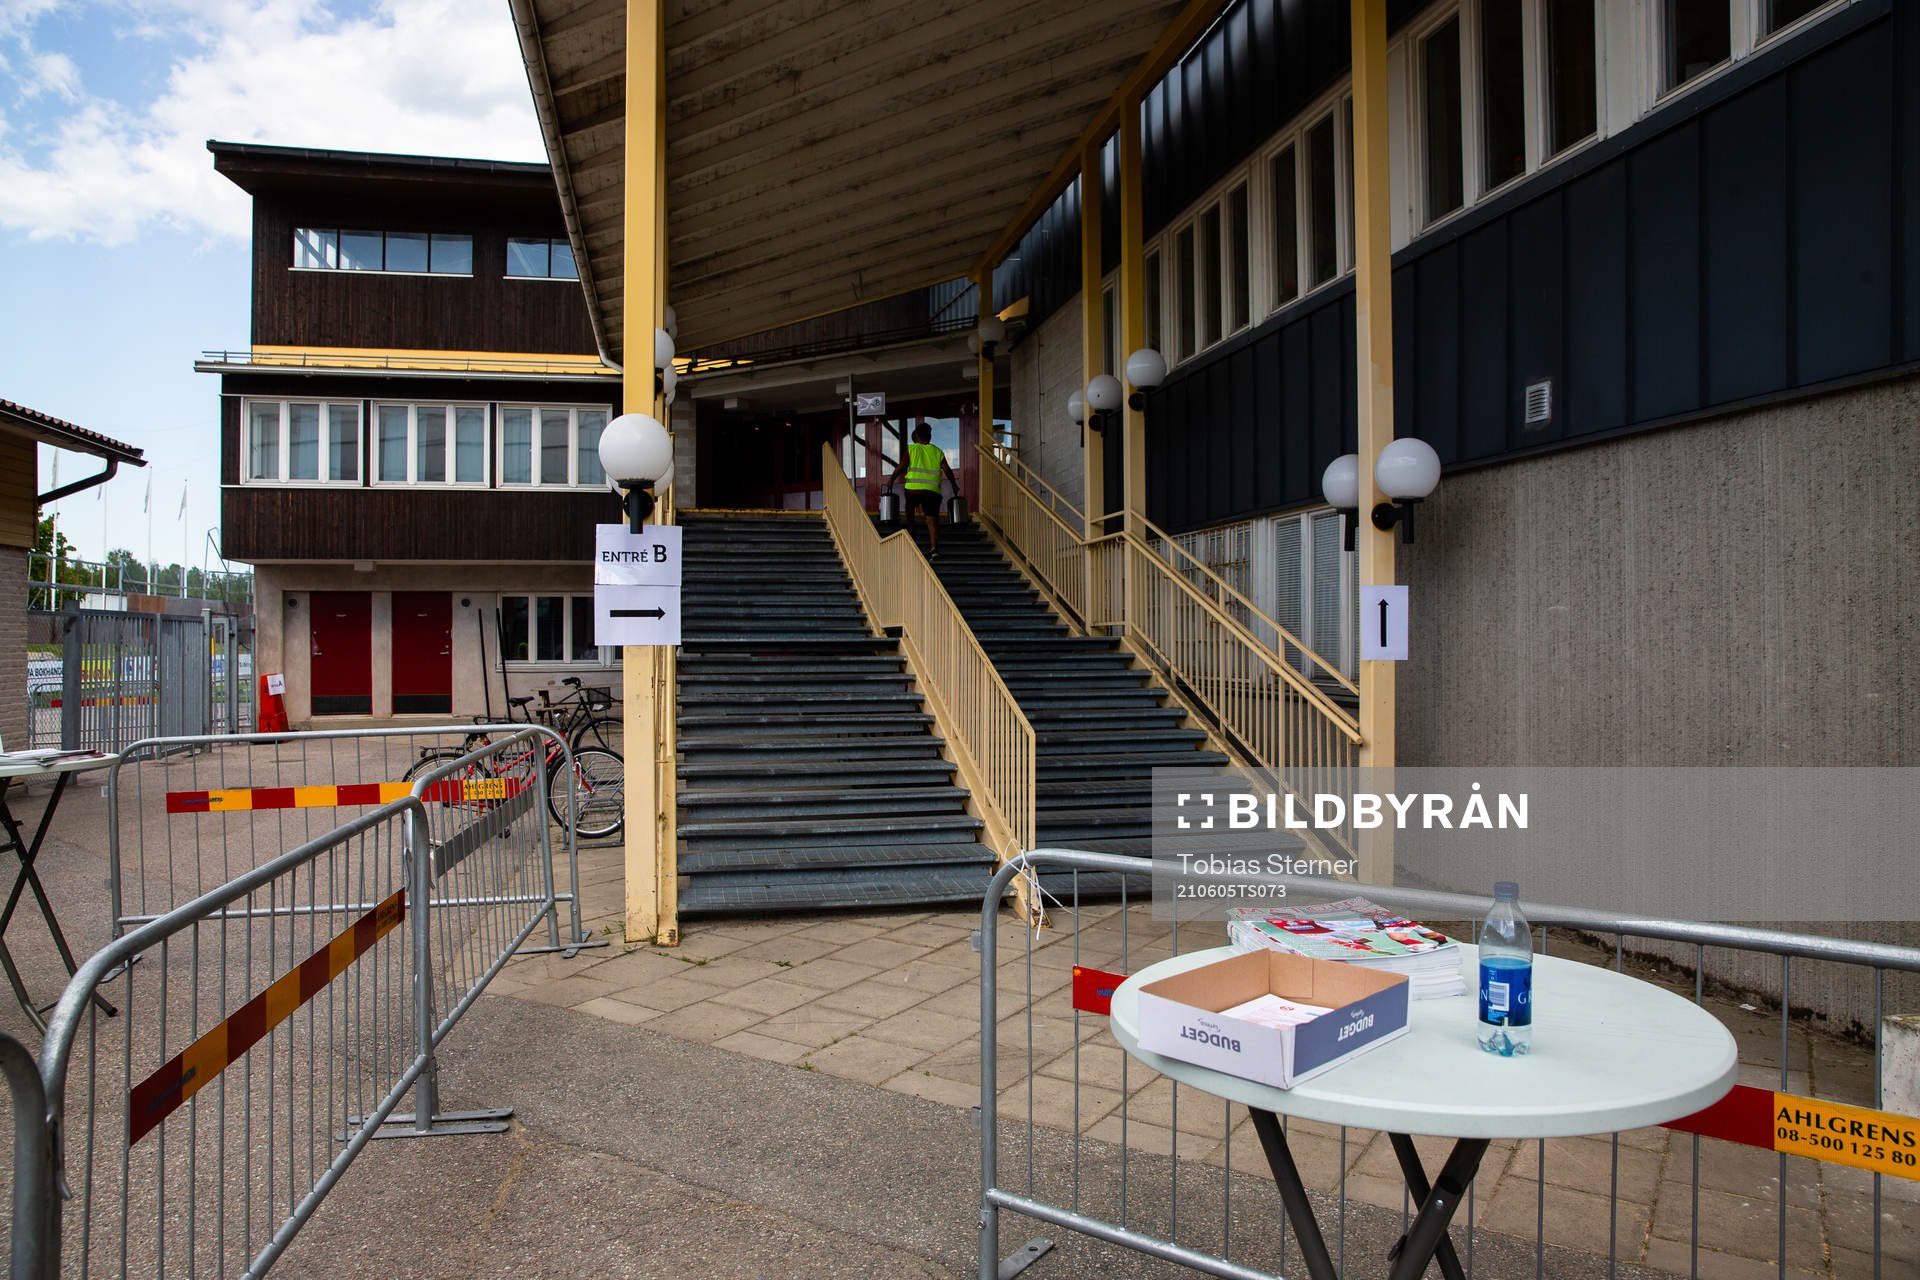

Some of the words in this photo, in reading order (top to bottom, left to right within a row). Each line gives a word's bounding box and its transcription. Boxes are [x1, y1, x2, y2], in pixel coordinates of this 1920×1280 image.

[602, 549, 649, 563] ENTRÉ
[652, 544, 667, 563] B
[1180, 1025, 1241, 1053] BUDGET
[1337, 1013, 1374, 1042] BUDGET
[1777, 1107, 1916, 1148] AHLGRENS
[1777, 1127, 1844, 1151] 08-500
[1851, 1142, 1885, 1160] 125
[1891, 1153, 1916, 1167] 80
